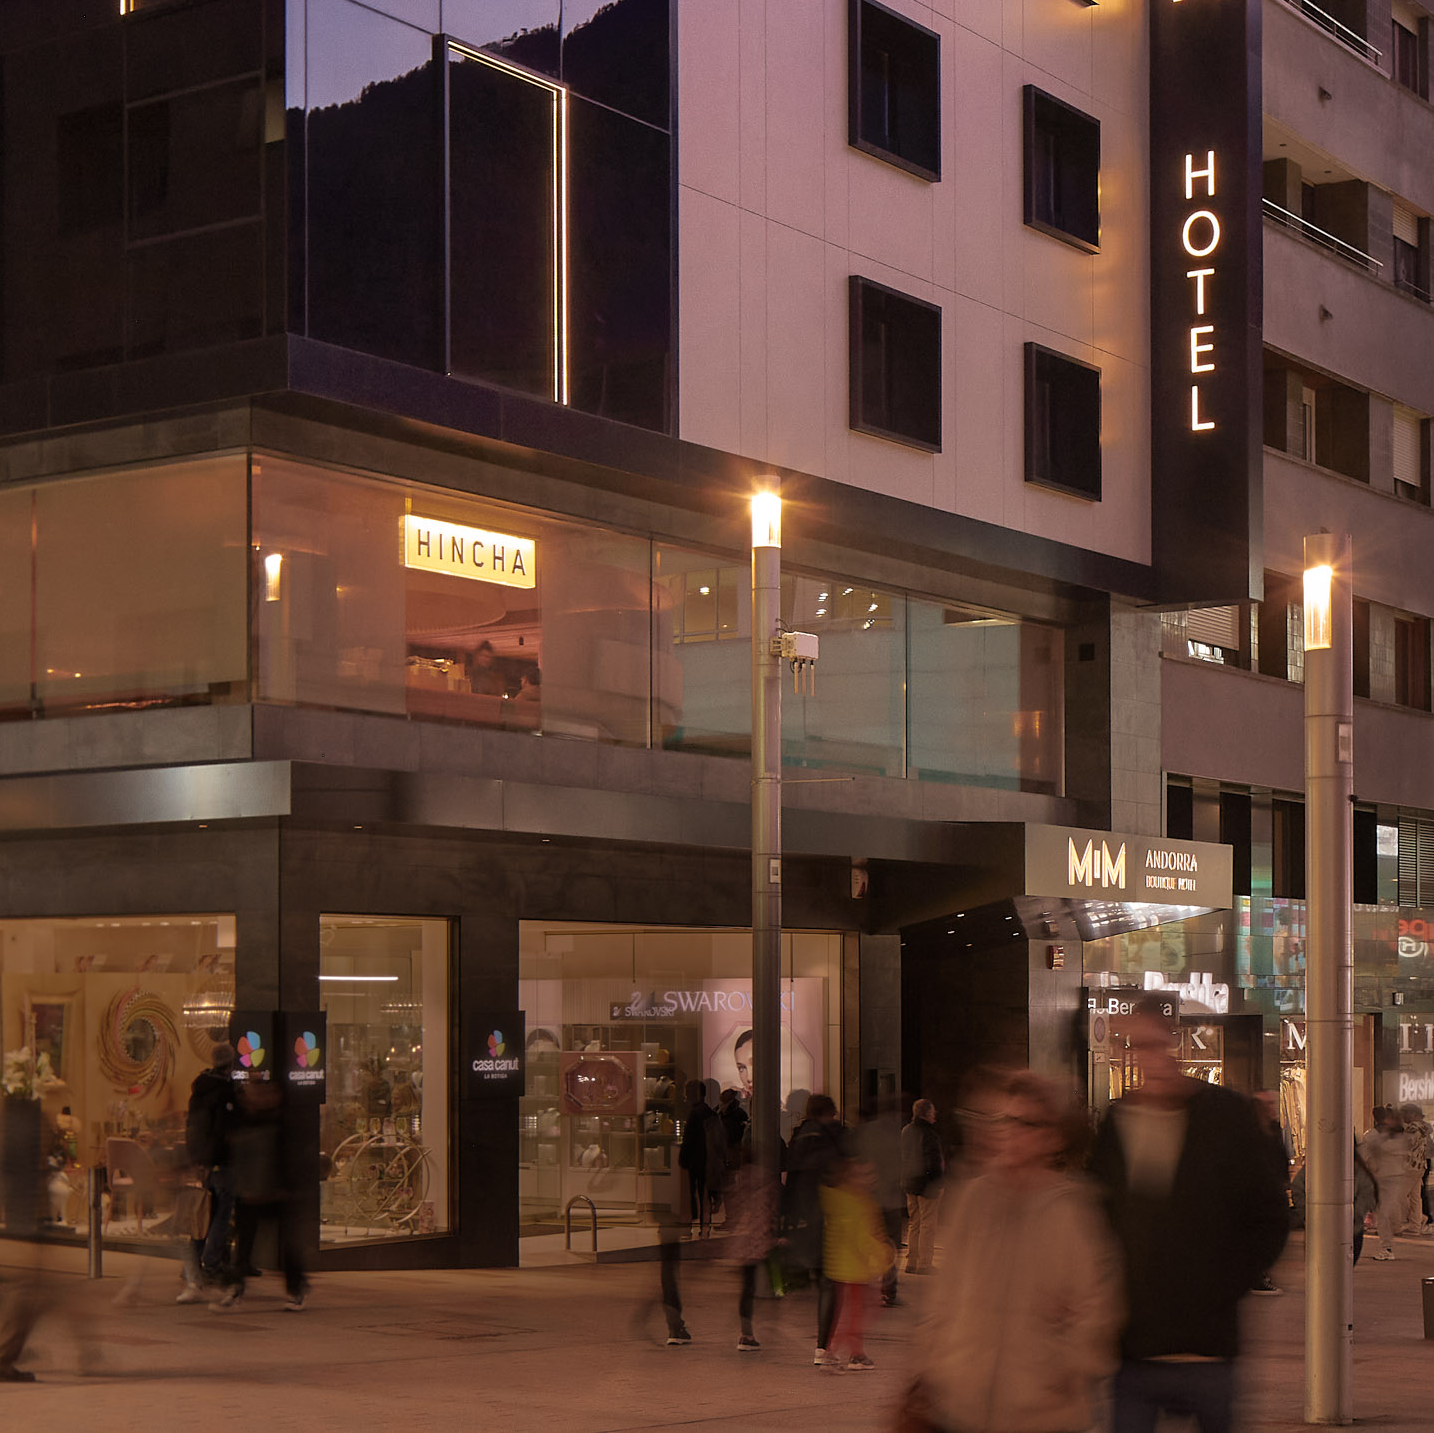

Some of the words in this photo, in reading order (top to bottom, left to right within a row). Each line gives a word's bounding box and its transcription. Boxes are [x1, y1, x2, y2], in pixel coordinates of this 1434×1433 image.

[1181, 149, 1221, 432] HOTEL
[417, 528, 527, 576] HINCHA
[1145, 849, 1198, 872] ANDORRA
[1145, 875, 1177, 891] BOUTIQUE
[472, 1059, 495, 1071] casa
[495, 1057, 520, 1071] canut
